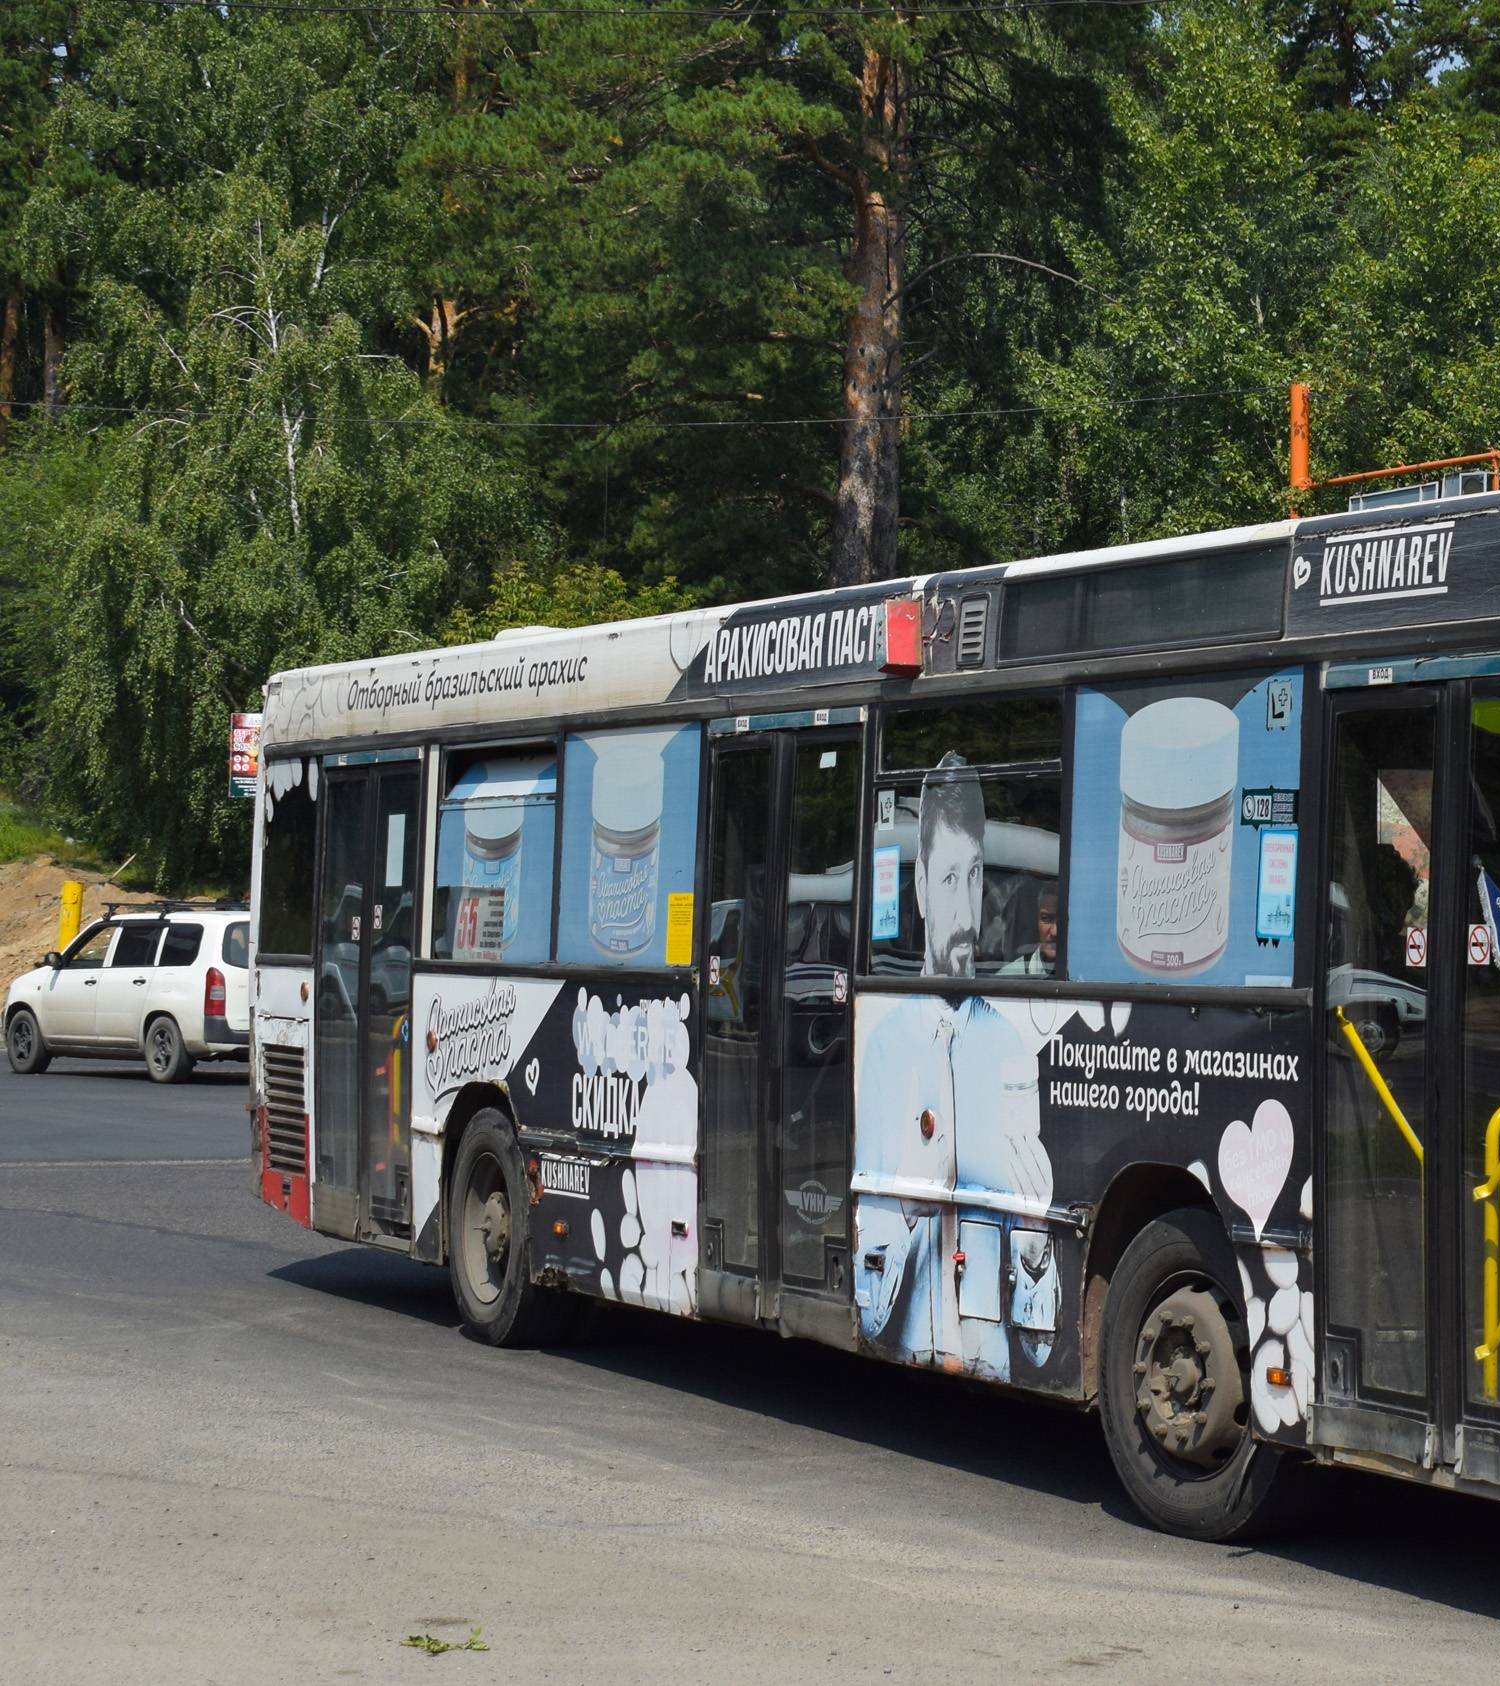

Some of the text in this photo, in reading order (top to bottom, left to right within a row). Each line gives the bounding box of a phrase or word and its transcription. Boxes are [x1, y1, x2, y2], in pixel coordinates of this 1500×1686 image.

[1320, 532, 1453, 595] KUSHNAREV
[704, 605, 878, 683] АРАХИСОВАЯ ПАСТ
[347, 656, 588, 717] Отборный бразильский арахис
[1372, 668, 1389, 680] ВХОД
[1257, 798, 1270, 818] 128
[1050, 1034, 1299, 1082] Покупайте в магазинах
[572, 1072, 640, 1139] СКИДКА
[1050, 1080, 1200, 1122] нашего города!
[541, 1160, 590, 1194] KUSHNAREV
